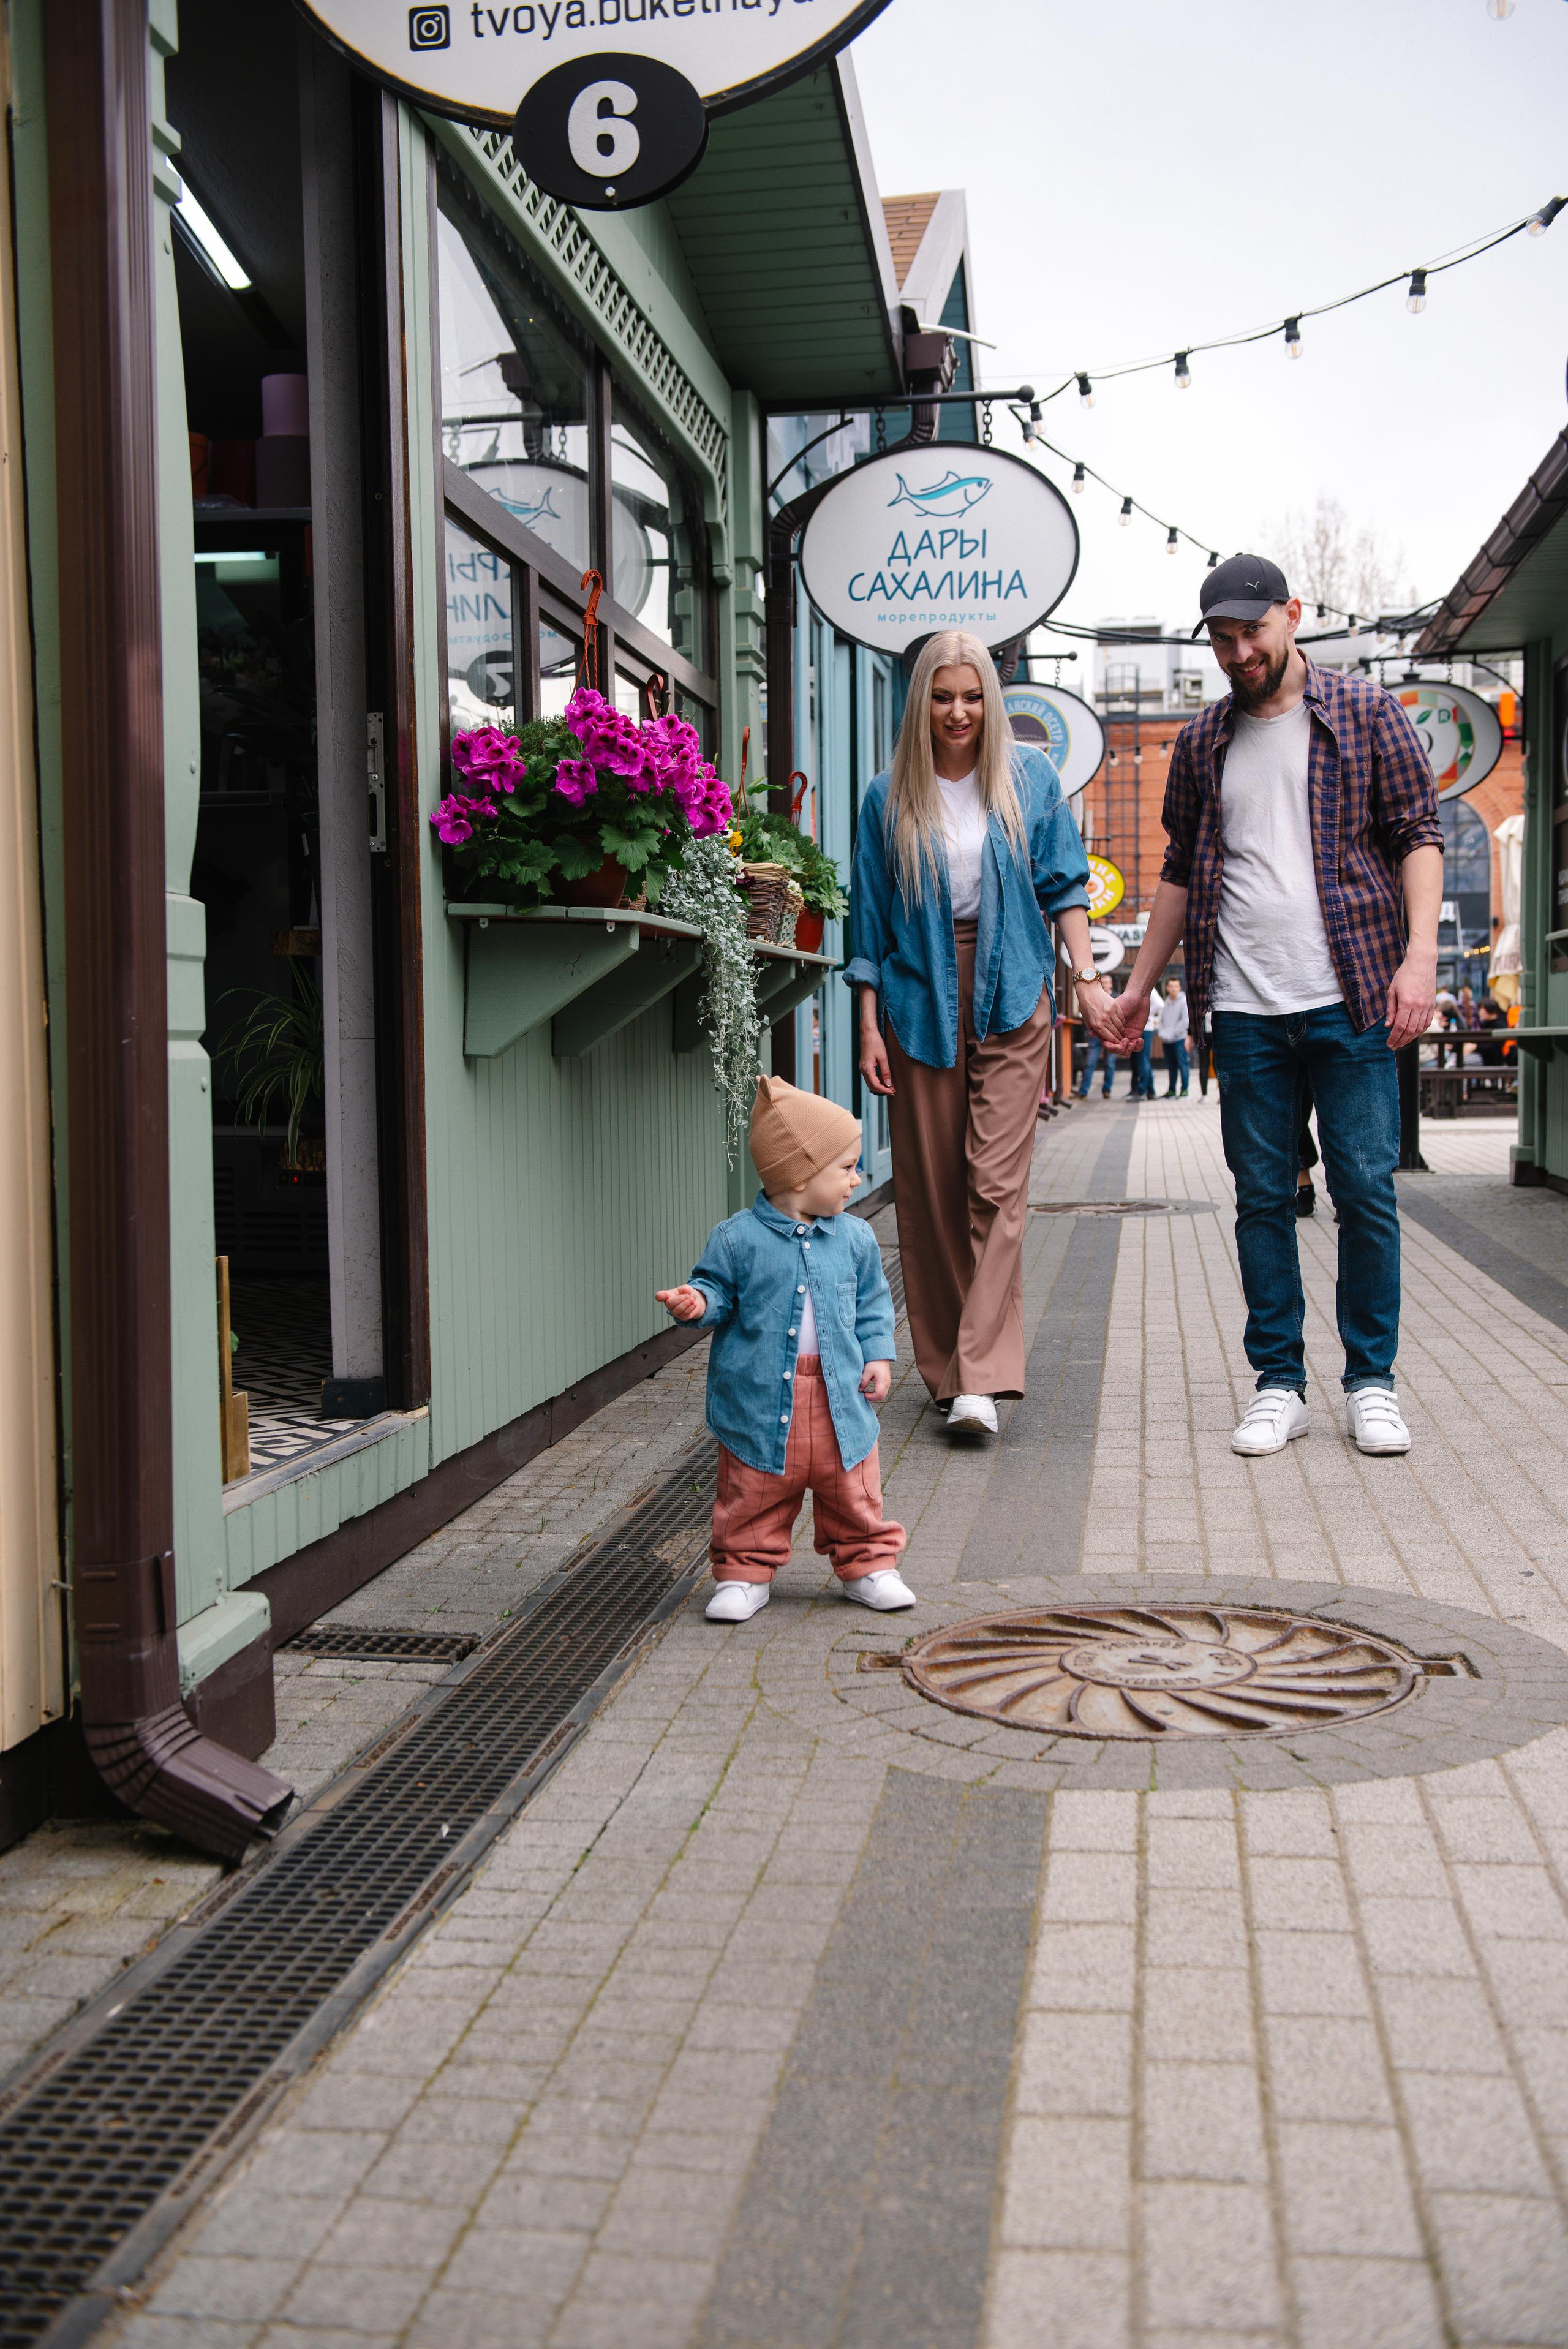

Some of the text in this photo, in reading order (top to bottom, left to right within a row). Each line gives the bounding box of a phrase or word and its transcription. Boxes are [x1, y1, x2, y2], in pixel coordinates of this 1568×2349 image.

[567, 79, 641, 178] 6
[888, 528, 987, 567] ДАРЫ
[848, 569, 1028, 601] САХАЛИНА
[877, 612, 997, 625] морепродукты
[1042, 711, 1063, 741] ОСЕТР
